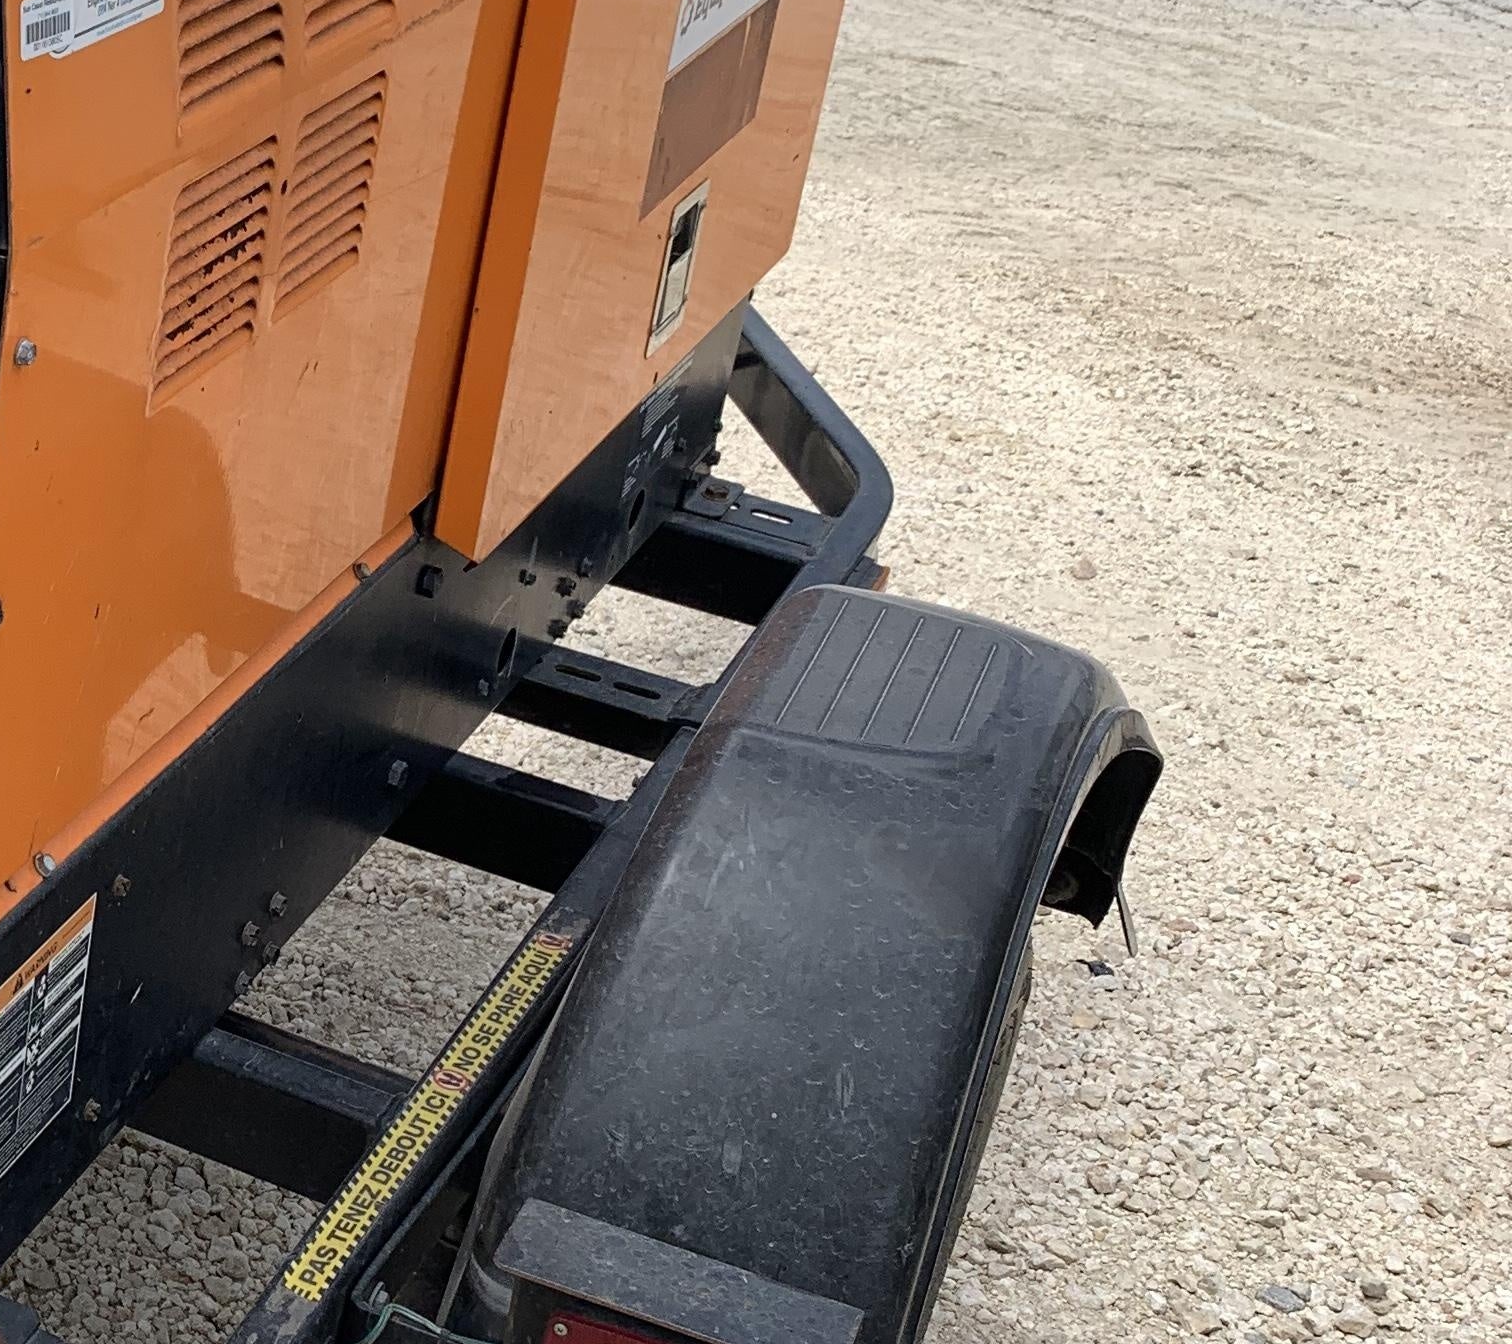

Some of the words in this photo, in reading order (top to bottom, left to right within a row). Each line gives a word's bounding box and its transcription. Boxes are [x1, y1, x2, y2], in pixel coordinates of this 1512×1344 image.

[299, 1244, 338, 1286] PAS
[326, 1183, 383, 1244] TENEZ
[370, 1114, 431, 1186] DEBOUT
[420, 1090, 451, 1115] ICI
[452, 1046, 482, 1072] NO
[471, 1023, 500, 1046] SE
[487, 984, 527, 1024] PARE
